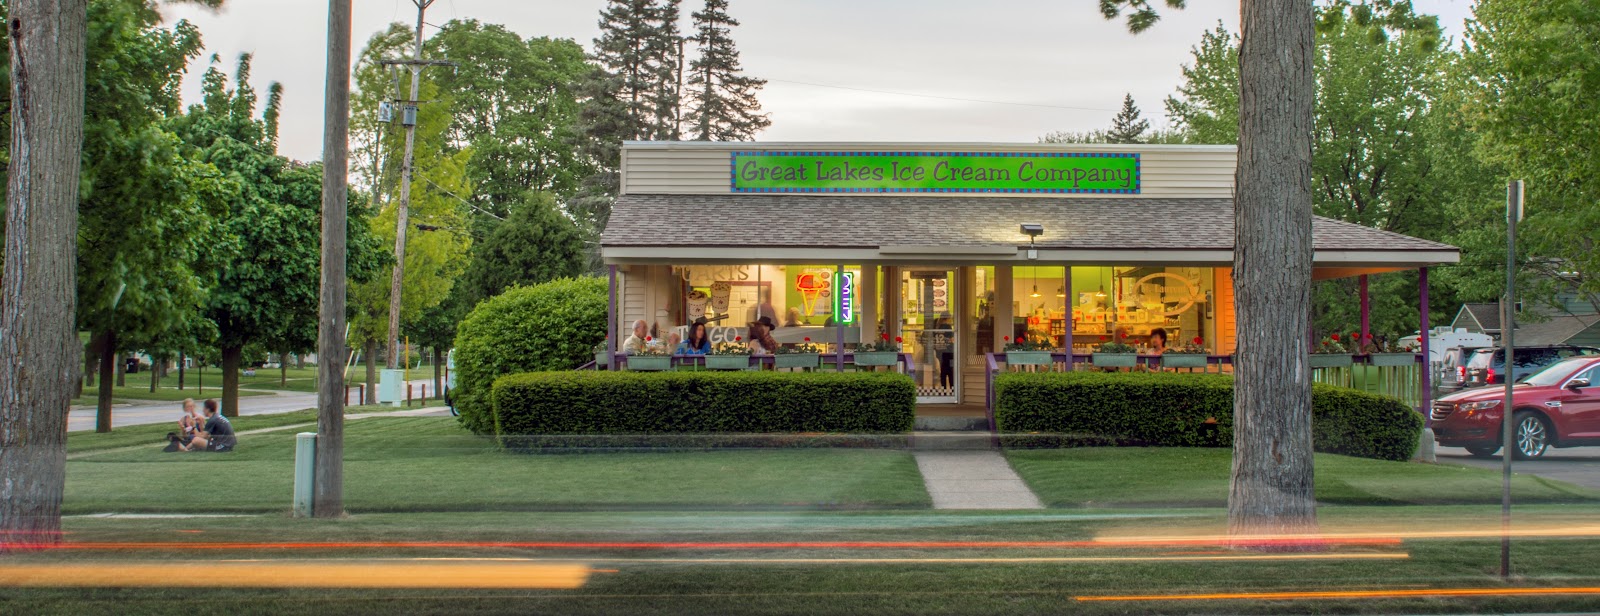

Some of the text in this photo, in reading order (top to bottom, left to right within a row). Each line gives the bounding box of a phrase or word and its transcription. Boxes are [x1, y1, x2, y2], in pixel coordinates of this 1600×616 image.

[741, 160, 1131, 188] Great Lakes Ice Cream Company
[710, 325, 739, 344] GO
